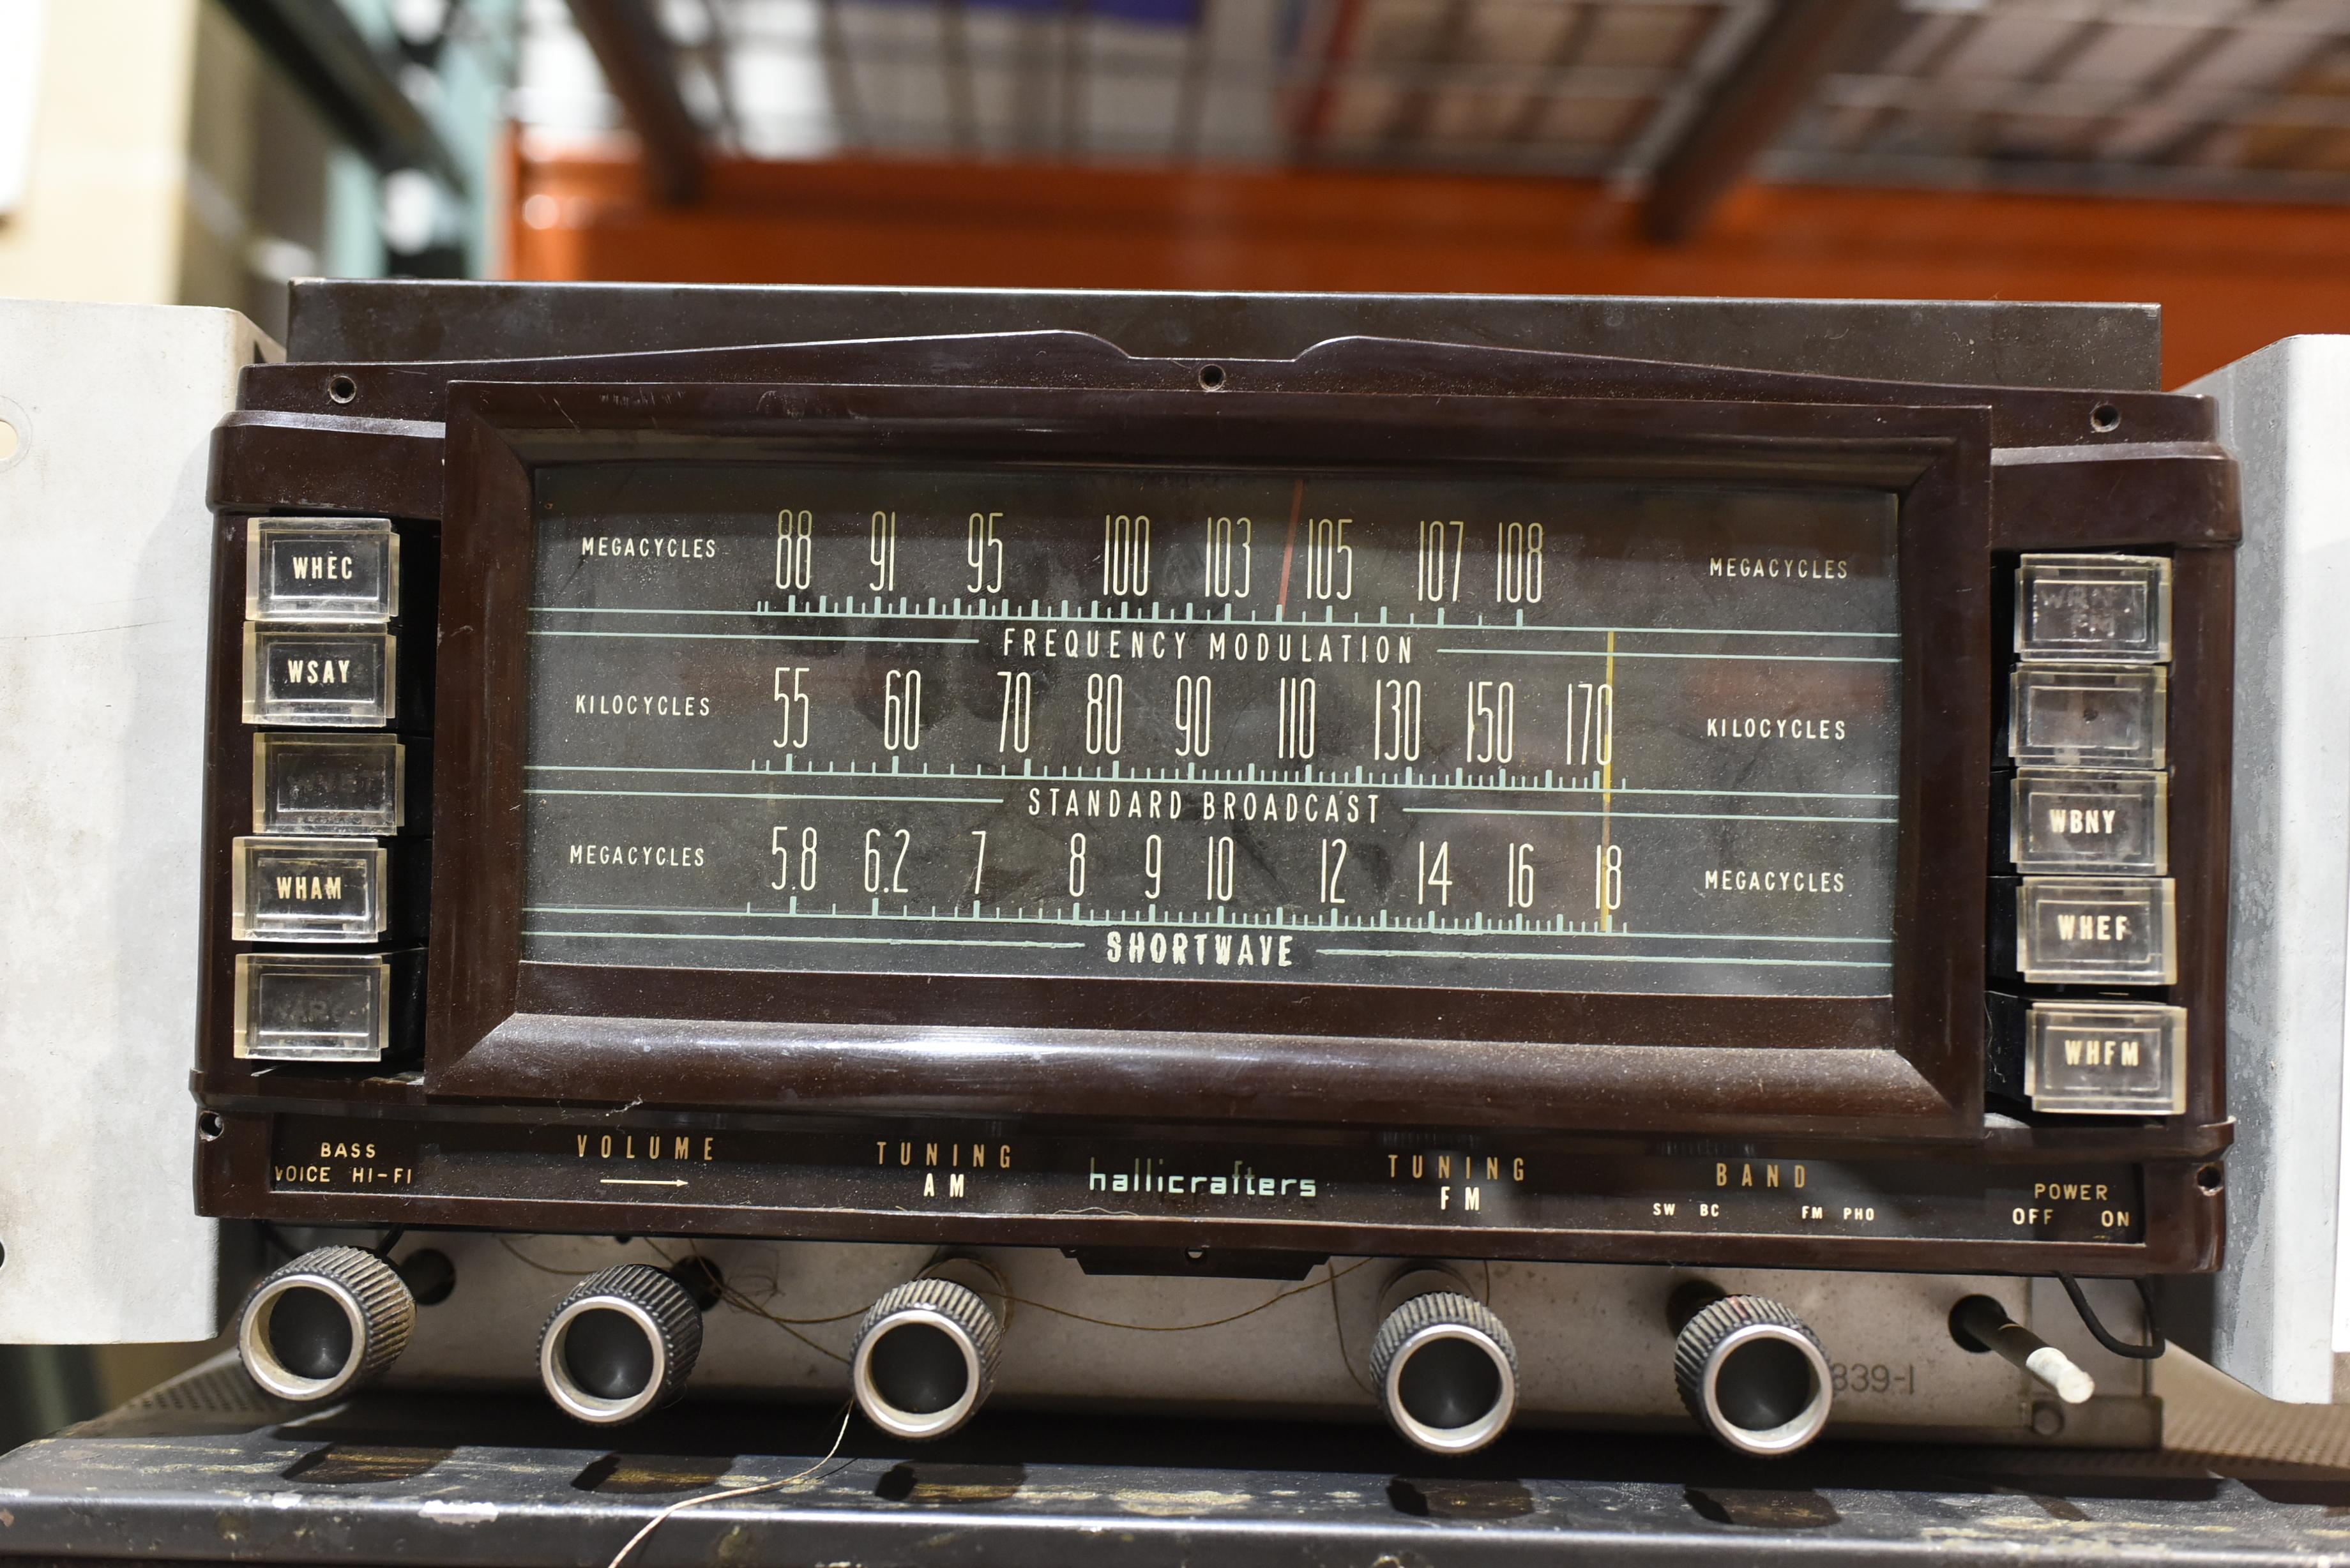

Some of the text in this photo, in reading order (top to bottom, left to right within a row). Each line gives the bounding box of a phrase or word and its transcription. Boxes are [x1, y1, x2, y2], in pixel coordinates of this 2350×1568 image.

[292, 555, 353, 580] WHEC
[581, 509, 1847, 604] MEGACYCLES 88 91 95 100 103 105 107 108 MEGACYCLES
[1004, 628, 1411, 664] FREQUENCY MODULATION
[287, 658, 351, 684] WSAY
[575, 667, 1846, 765] KILOCYCLES 55 60 70 80 90 110 130 150 170 KILOCYCLES
[1028, 787, 1379, 824] STANDARD BROADCAST
[2049, 809, 2116, 834] WBNY
[570, 825, 1844, 910] MEGACYCLES 5.8 6.2 7 8 9 10 12 14 16 18 MEGACYCLES
[277, 876, 341, 901] WHAM
[1107, 931, 1293, 967] SHORTWAVE
[2065, 1039, 2139, 1066] WHFM
[321, 1142, 375, 1158] BASS
[577, 1135, 713, 1160] VOLUME
[877, 1142, 1010, 1168] TUNING
[276, 1165, 411, 1184] VOICE HI-FI
[1089, 1157, 1316, 1198] hallicrafters
[1388, 1155, 1524, 1181] TUNING
[1717, 1163, 1805, 1188] BAND
[923, 1173, 964, 1198] AM
[2035, 1183, 2107, 1200] POWER
[1441, 1186, 1480, 1211] FM
[1653, 1203, 1874, 1221] SW BC FM PHO
[2012, 1207, 2129, 1228] OFF ON
